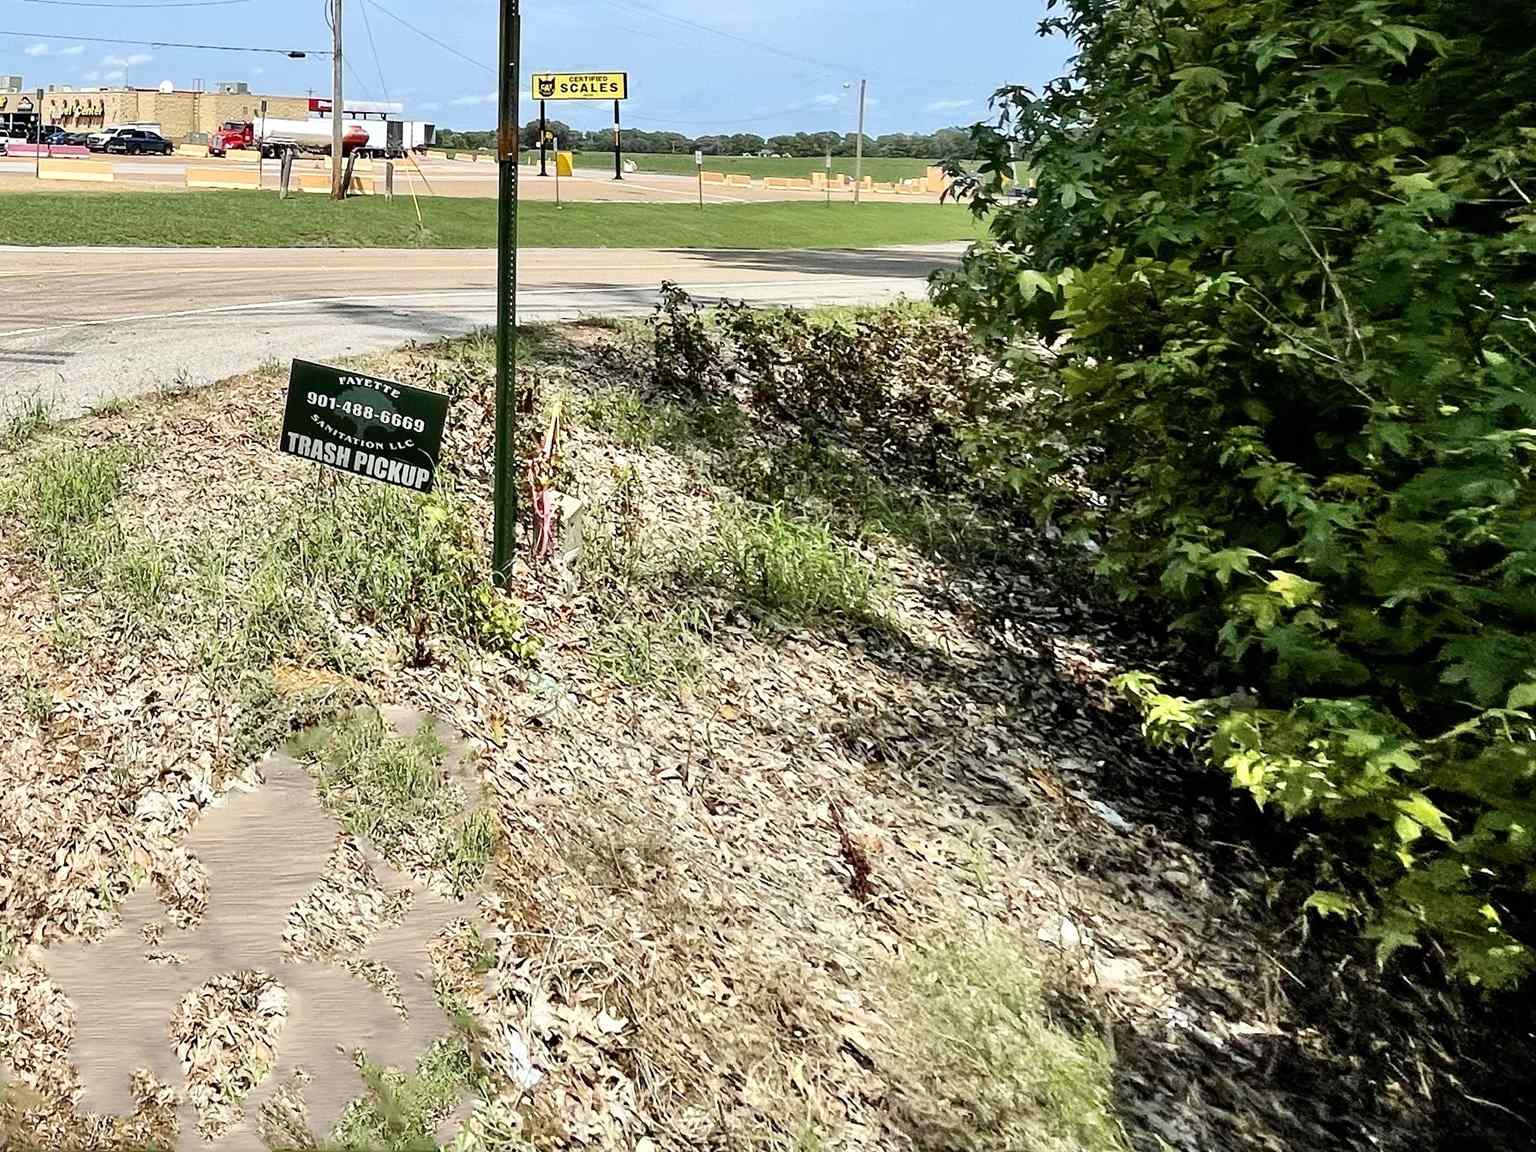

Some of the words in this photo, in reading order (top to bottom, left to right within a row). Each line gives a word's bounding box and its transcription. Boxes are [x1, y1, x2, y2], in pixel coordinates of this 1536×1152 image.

[560, 82, 619, 93] SCALES
[338, 376, 401, 399] FAYETTE
[306, 391, 425, 433] 901-488-6669
[310, 414, 384, 450] SANITATION
[389, 439, 415, 450] LLC
[287, 431, 351, 469] TRASH
[354, 450, 430, 489] PICKUP
